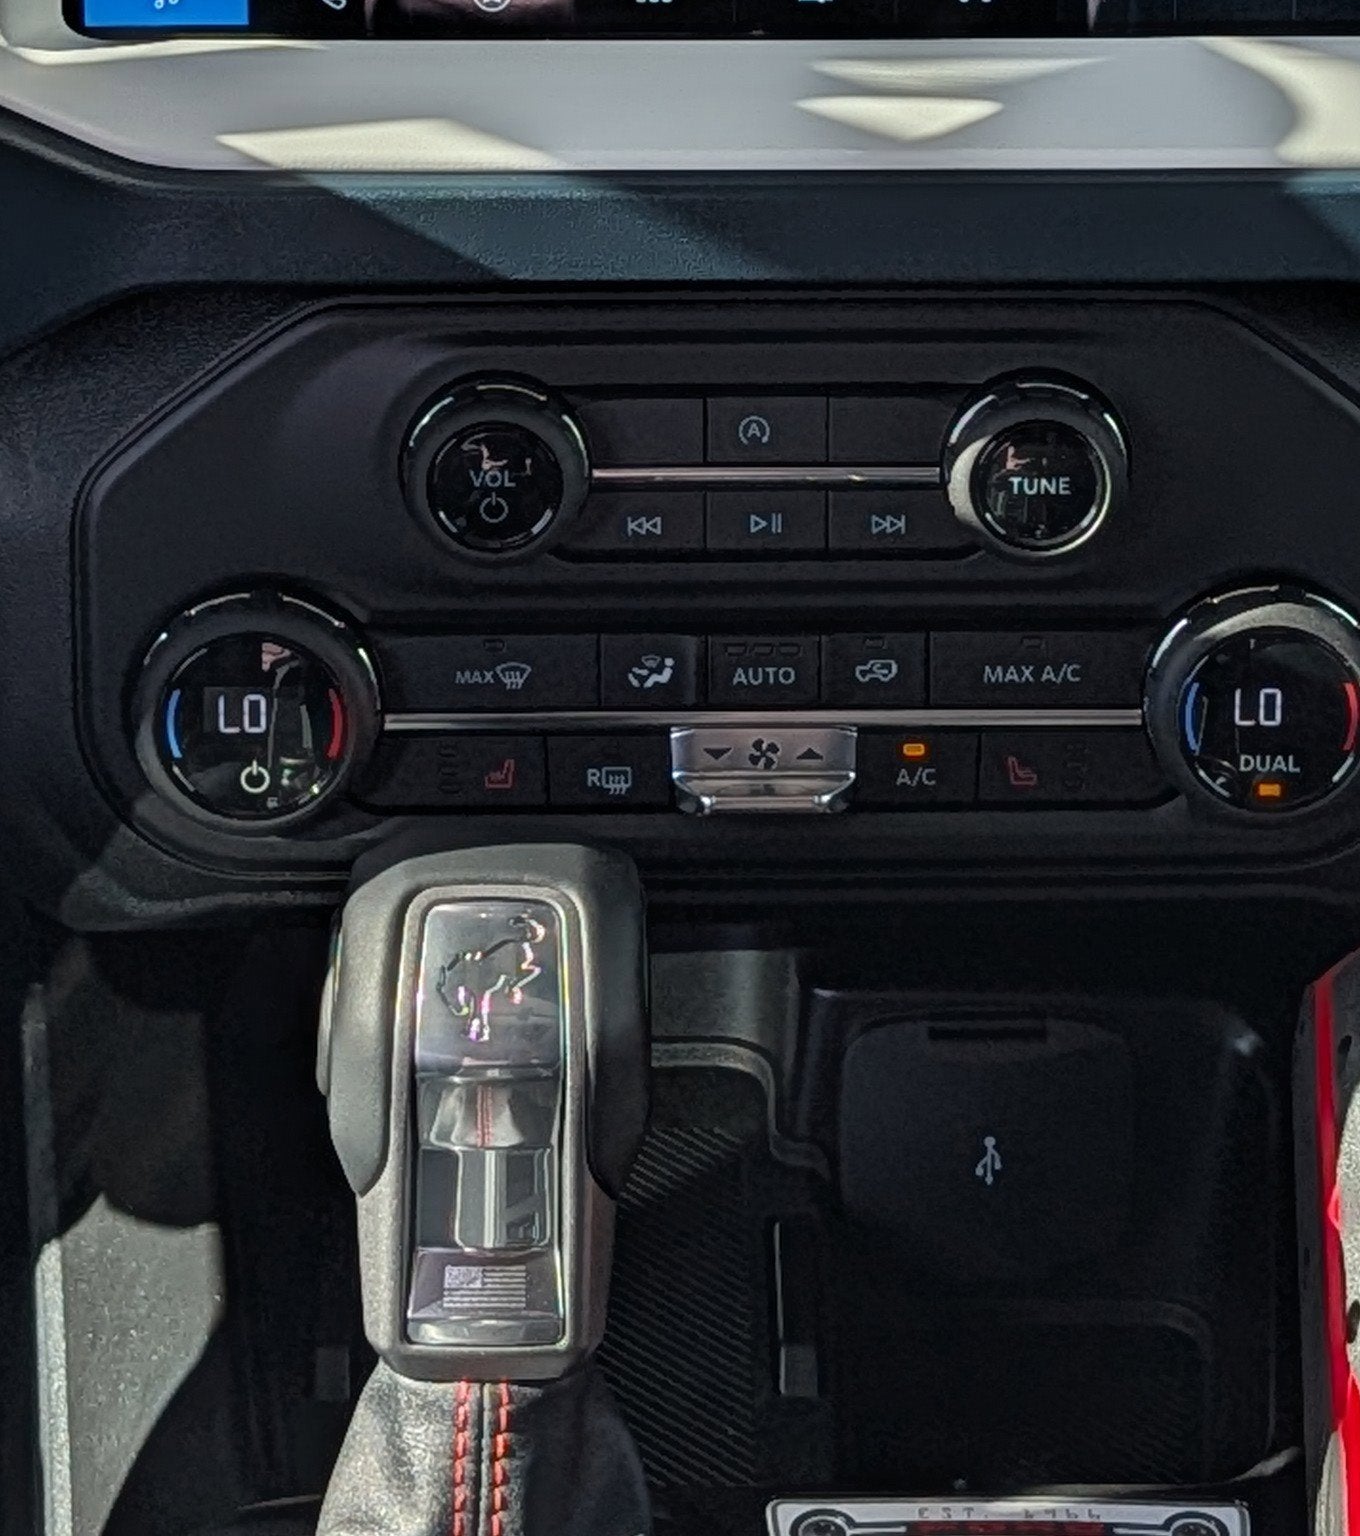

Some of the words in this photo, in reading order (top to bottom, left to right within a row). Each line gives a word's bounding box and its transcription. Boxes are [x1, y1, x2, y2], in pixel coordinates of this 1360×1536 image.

[468, 469, 517, 489] VOL
[1008, 476, 1072, 497] TUNE
[454, 669, 495, 686] MAX
[731, 667, 797, 686] AUTO
[982, 664, 1035, 684] MAX
[1039, 663, 1082, 684] A/C
[1239, 754, 1301, 774] DUAL
[895, 767, 937, 787] A/C
